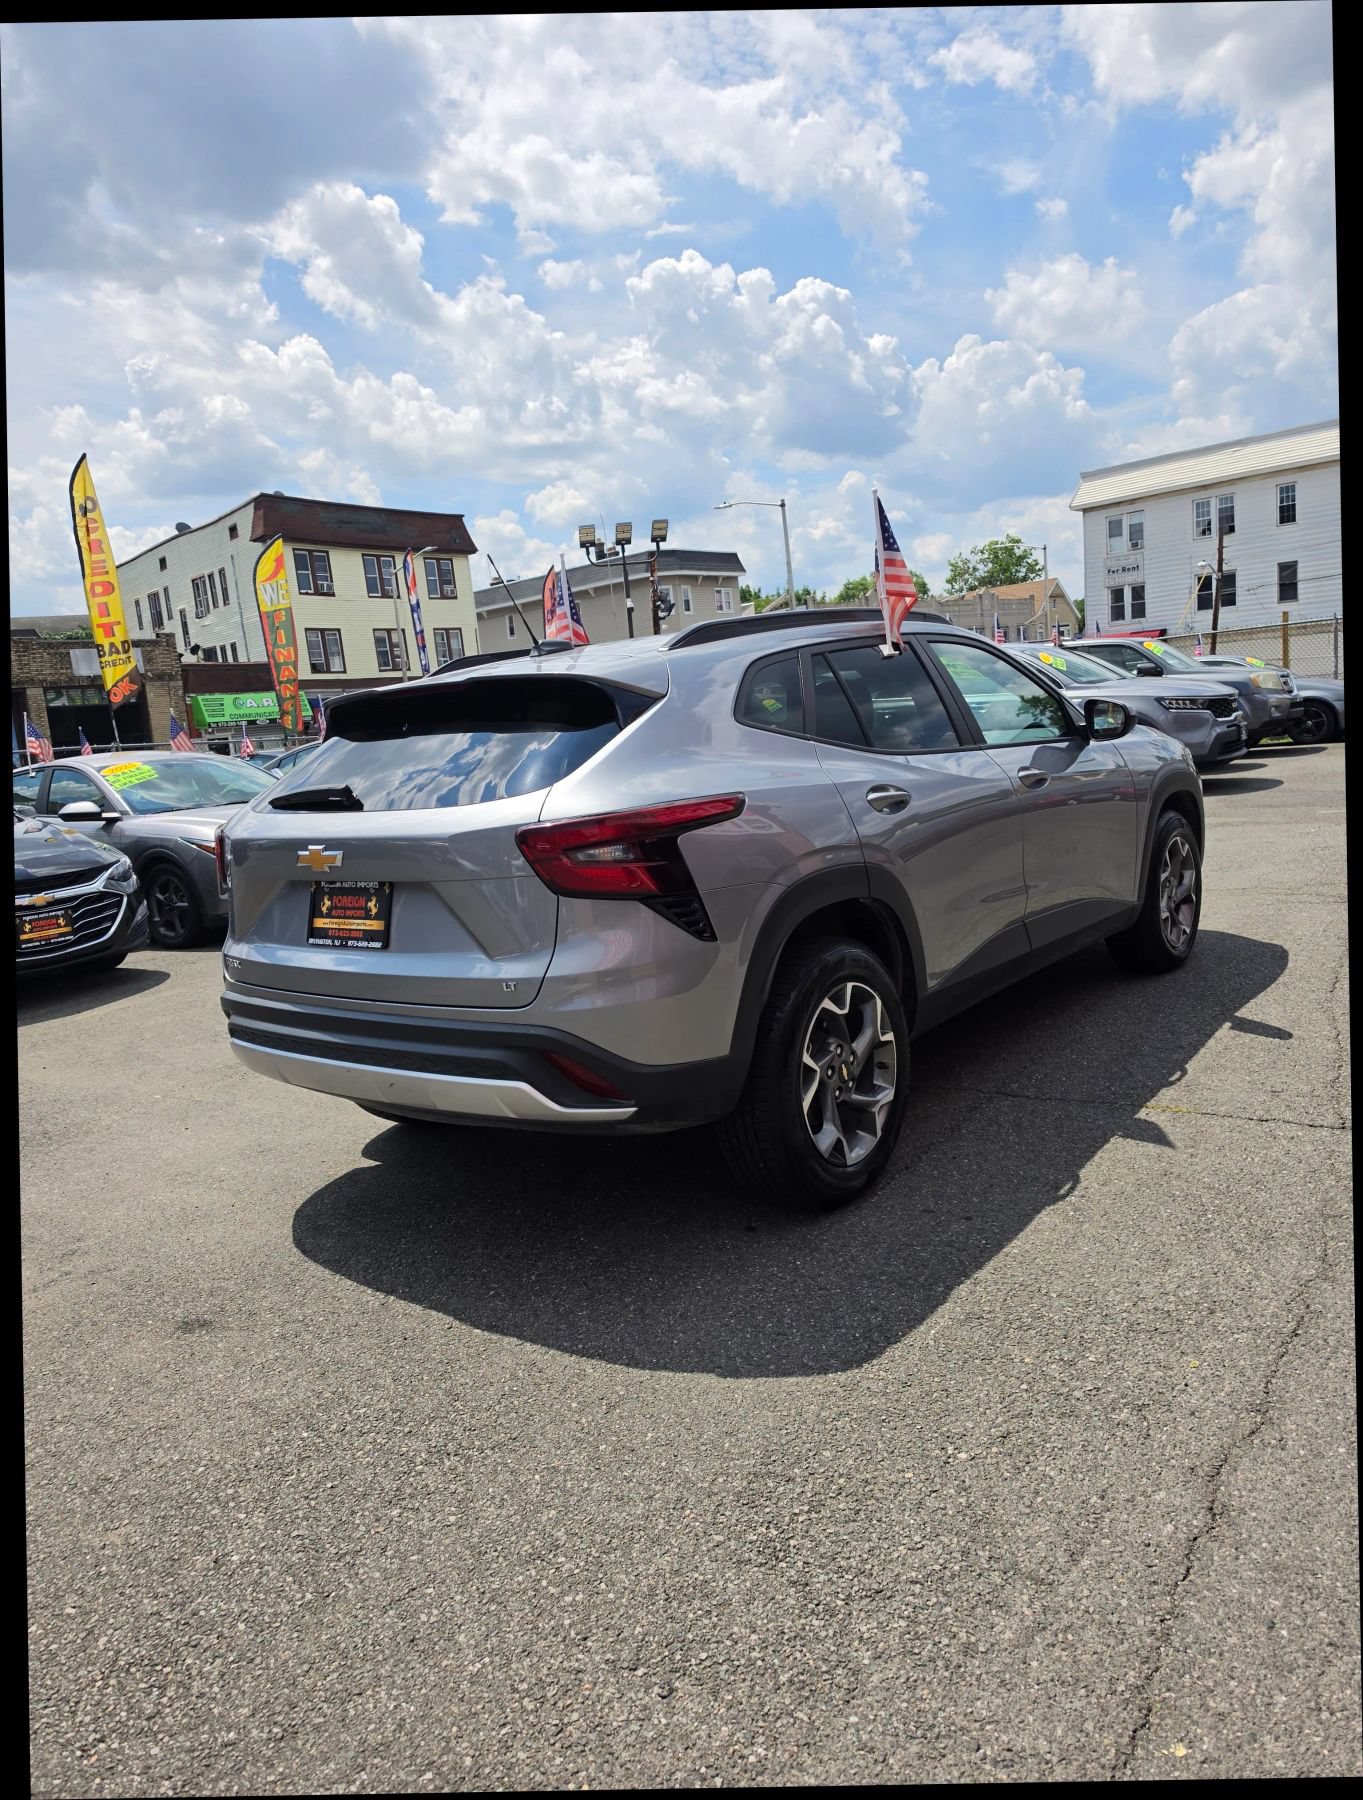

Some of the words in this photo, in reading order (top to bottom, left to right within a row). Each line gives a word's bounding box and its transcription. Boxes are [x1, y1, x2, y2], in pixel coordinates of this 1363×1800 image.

[260, 580, 290, 608] WE
[97, 640, 131, 659] BAD
[99, 655, 132, 670] CREDIT
[274, 610, 298, 729] FINANCE
[109, 677, 138, 704] OK
[332, 896, 365, 907] FOREIGN
[502, 981, 516, 992] LT
